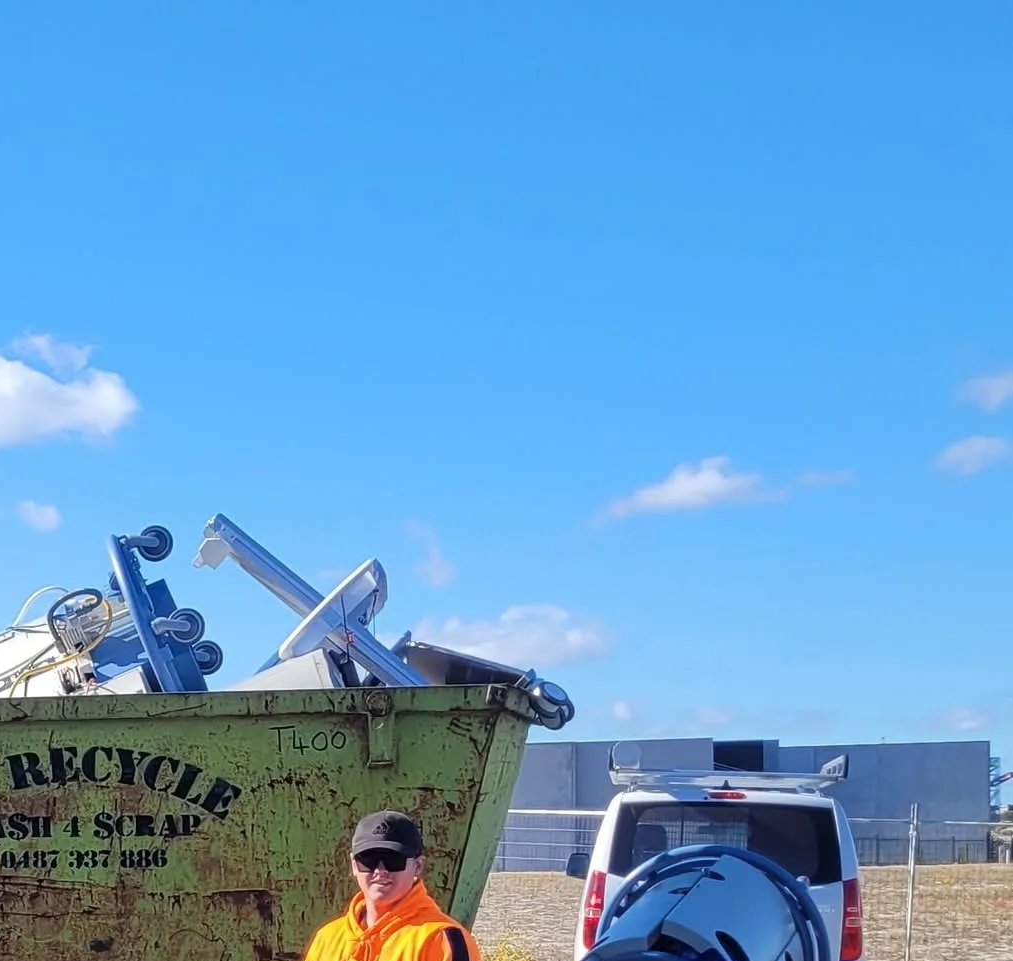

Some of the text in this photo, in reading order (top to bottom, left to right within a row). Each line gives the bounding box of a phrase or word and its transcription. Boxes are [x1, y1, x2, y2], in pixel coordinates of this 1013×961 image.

[268, 725, 346, 756] T400
[4, 746, 242, 820] RECYCLE
[63, 815, 82, 837] 4
[93, 810, 202, 839] $CRAP
[0, 849, 168, 869] 0487 337 886
